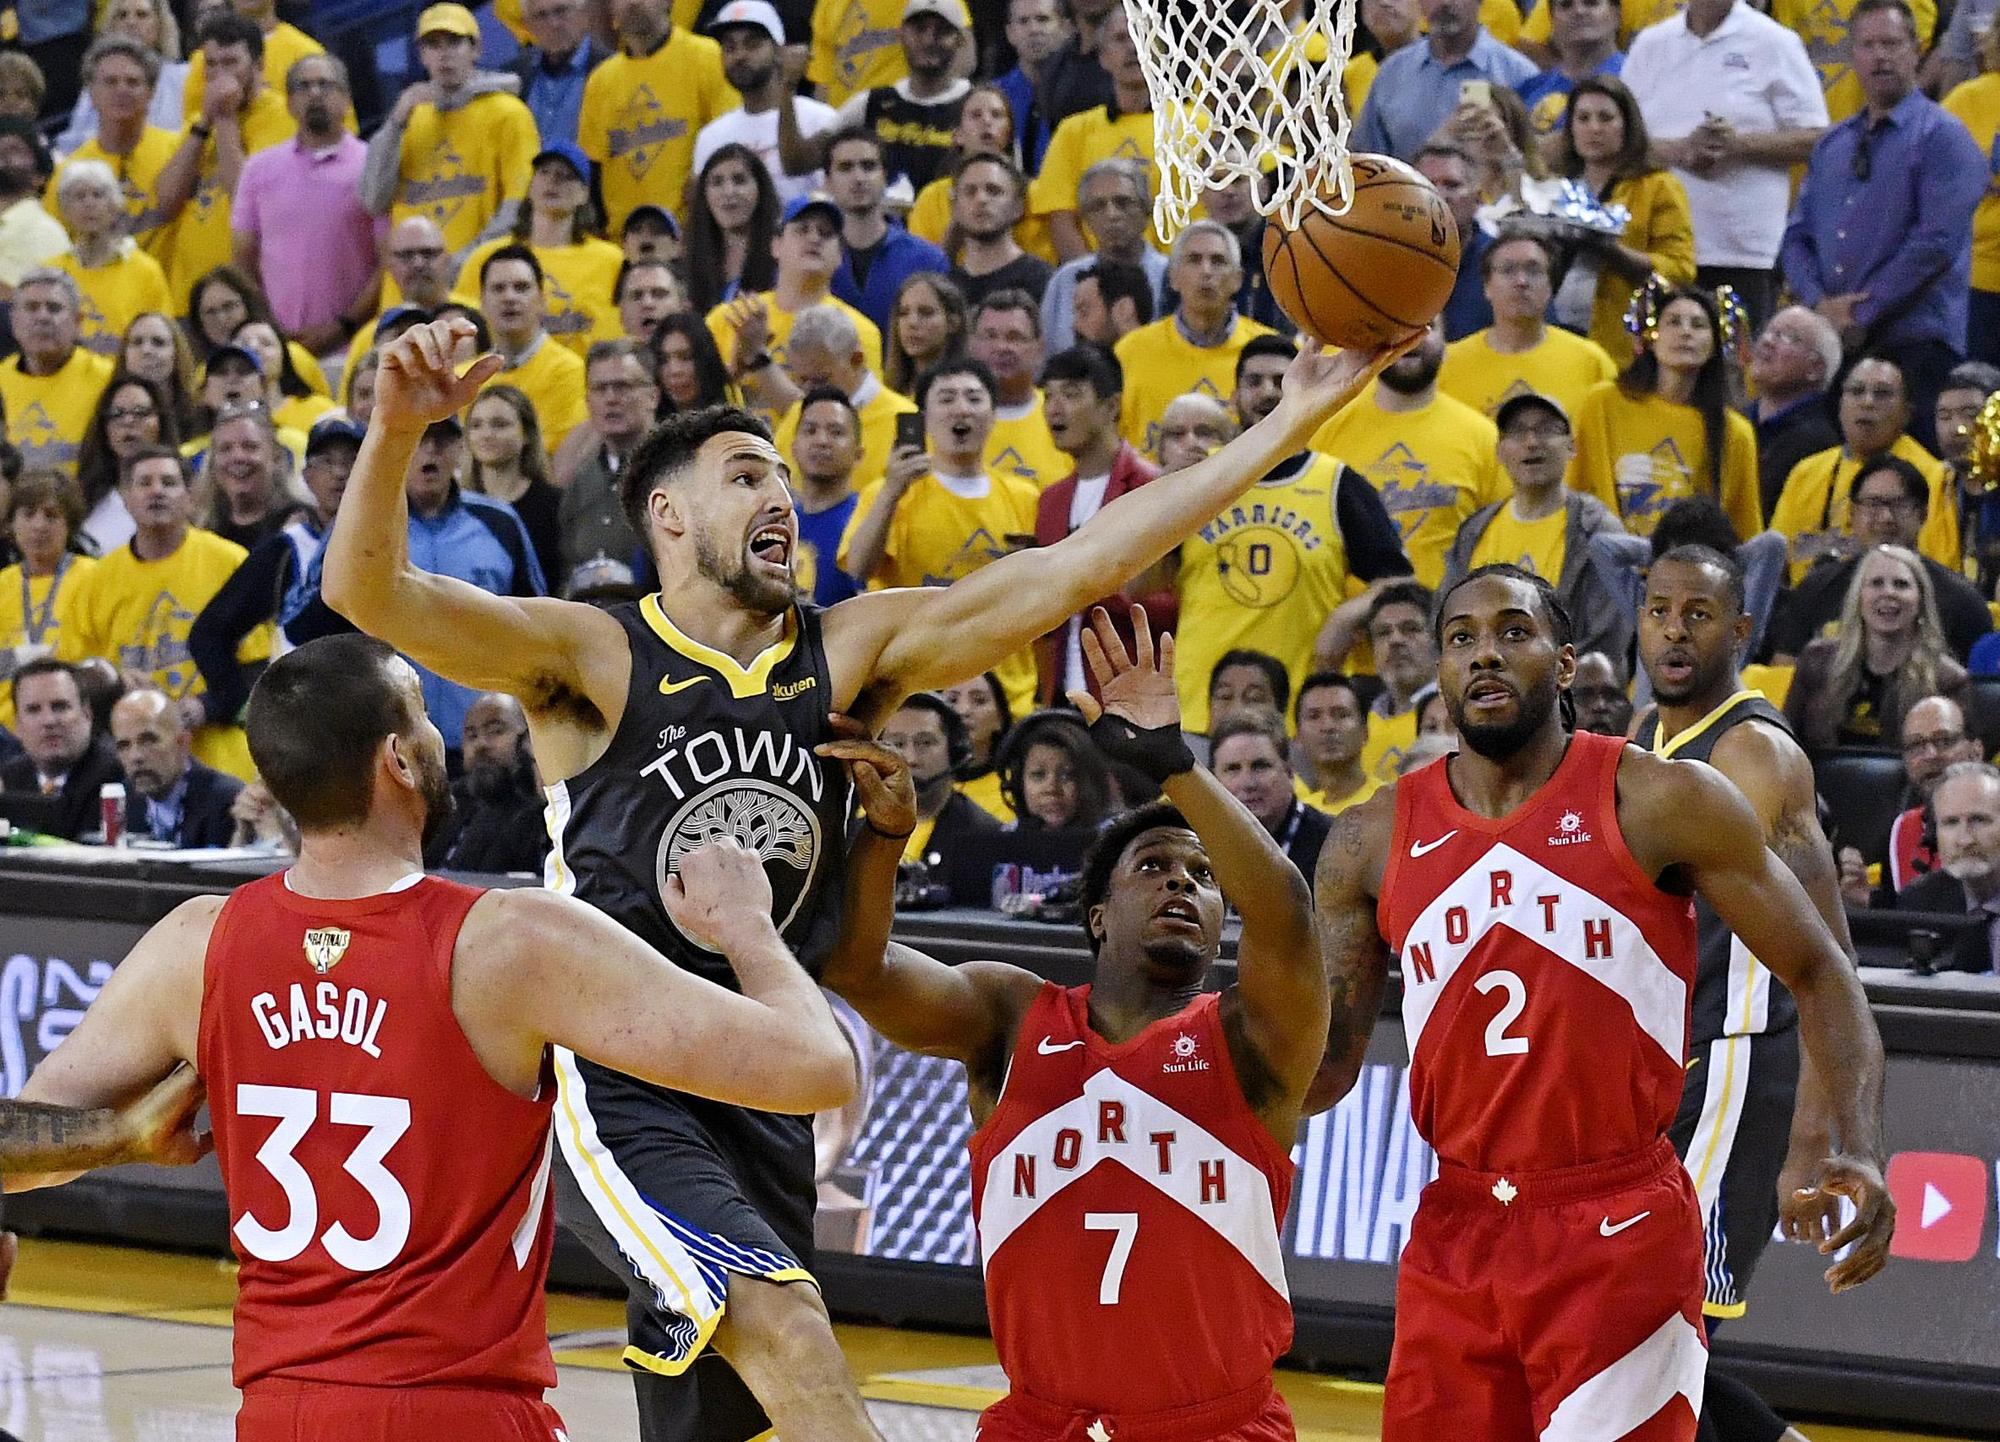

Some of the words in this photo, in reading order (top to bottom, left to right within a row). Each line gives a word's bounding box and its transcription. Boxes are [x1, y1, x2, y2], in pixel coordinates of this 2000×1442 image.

[1250, 544, 1271, 574] 0
[639, 727, 824, 803] TOWN
[656, 724, 687, 749] The
[1548, 836, 1569, 846] Sun
[1571, 832, 1592, 844] Life
[1409, 869, 1614, 986] NORTH
[250, 981, 388, 1059] GASOL
[1473, 969, 1530, 1057] 2
[1162, 1062, 1186, 1073] Sun
[1187, 1058, 1210, 1071] Life
[232, 1083, 412, 1272] 33
[1012, 1099, 1233, 1204] NORTH
[1084, 1212, 1139, 1305] 7
